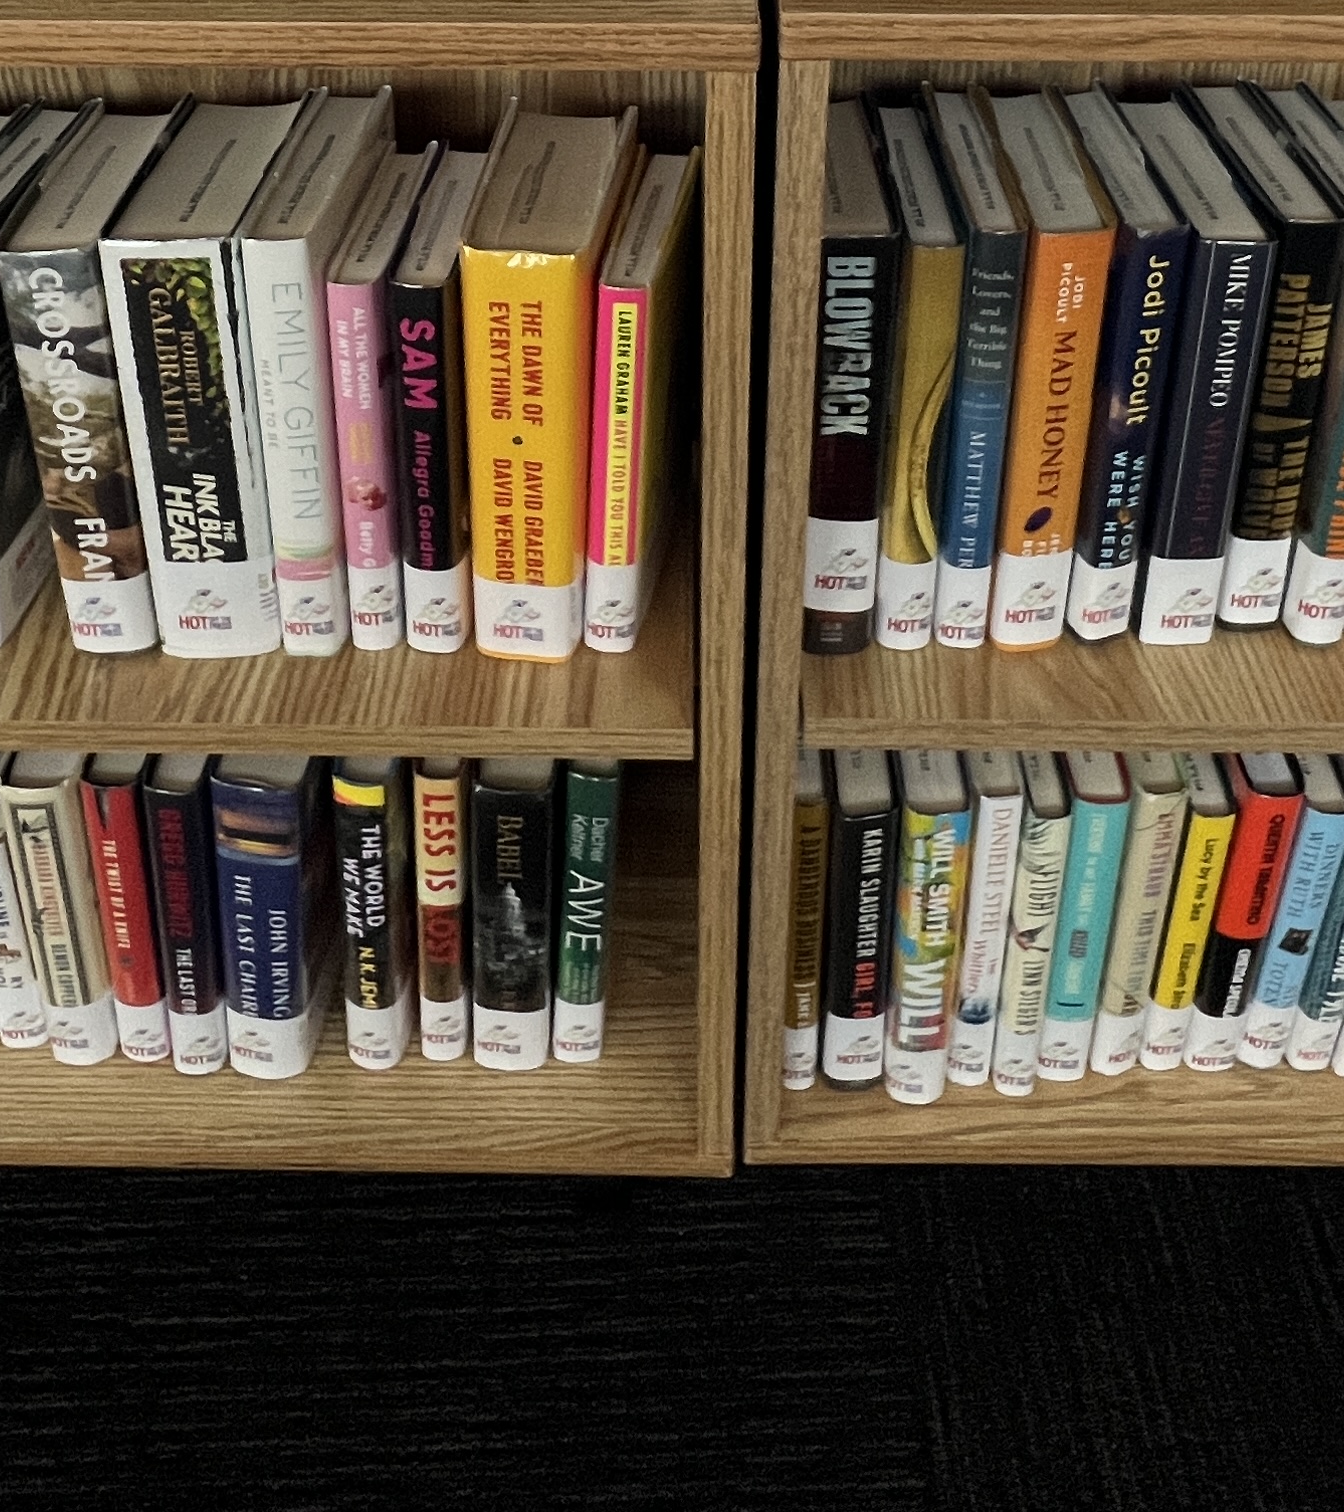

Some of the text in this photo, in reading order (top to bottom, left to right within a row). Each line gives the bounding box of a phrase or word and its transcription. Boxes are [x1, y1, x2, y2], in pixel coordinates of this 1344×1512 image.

[28, 268, 96, 482] CROSSROADS
[148, 288, 189, 445] GALBRAITH
[179, 331, 201, 406] ROBERT
[400, 318, 437, 408] SAM
[489, 302, 511, 420] EVERYTHING
[521, 301, 543, 426] THE DAWN OF
[615, 311, 632, 414] LAUREN GRAHAM
[1126, 256, 1169, 424] Jodi Picoult
[272, 283, 322, 521] EMILY GIFFIN
[1038, 332, 1075, 500] MAD HONEY
[192, 473, 219, 516] INK
[523, 461, 543, 510] DAVID
[961, 432, 986, 526] MATTHEW
[423, 793, 456, 891] LESS IS
[268, 909, 288, 953] JOHN
[365, 864, 386, 926] WORLD
[564, 870, 605, 952] AWE
[855, 828, 883, 958] KARIN SLAUGHTER
